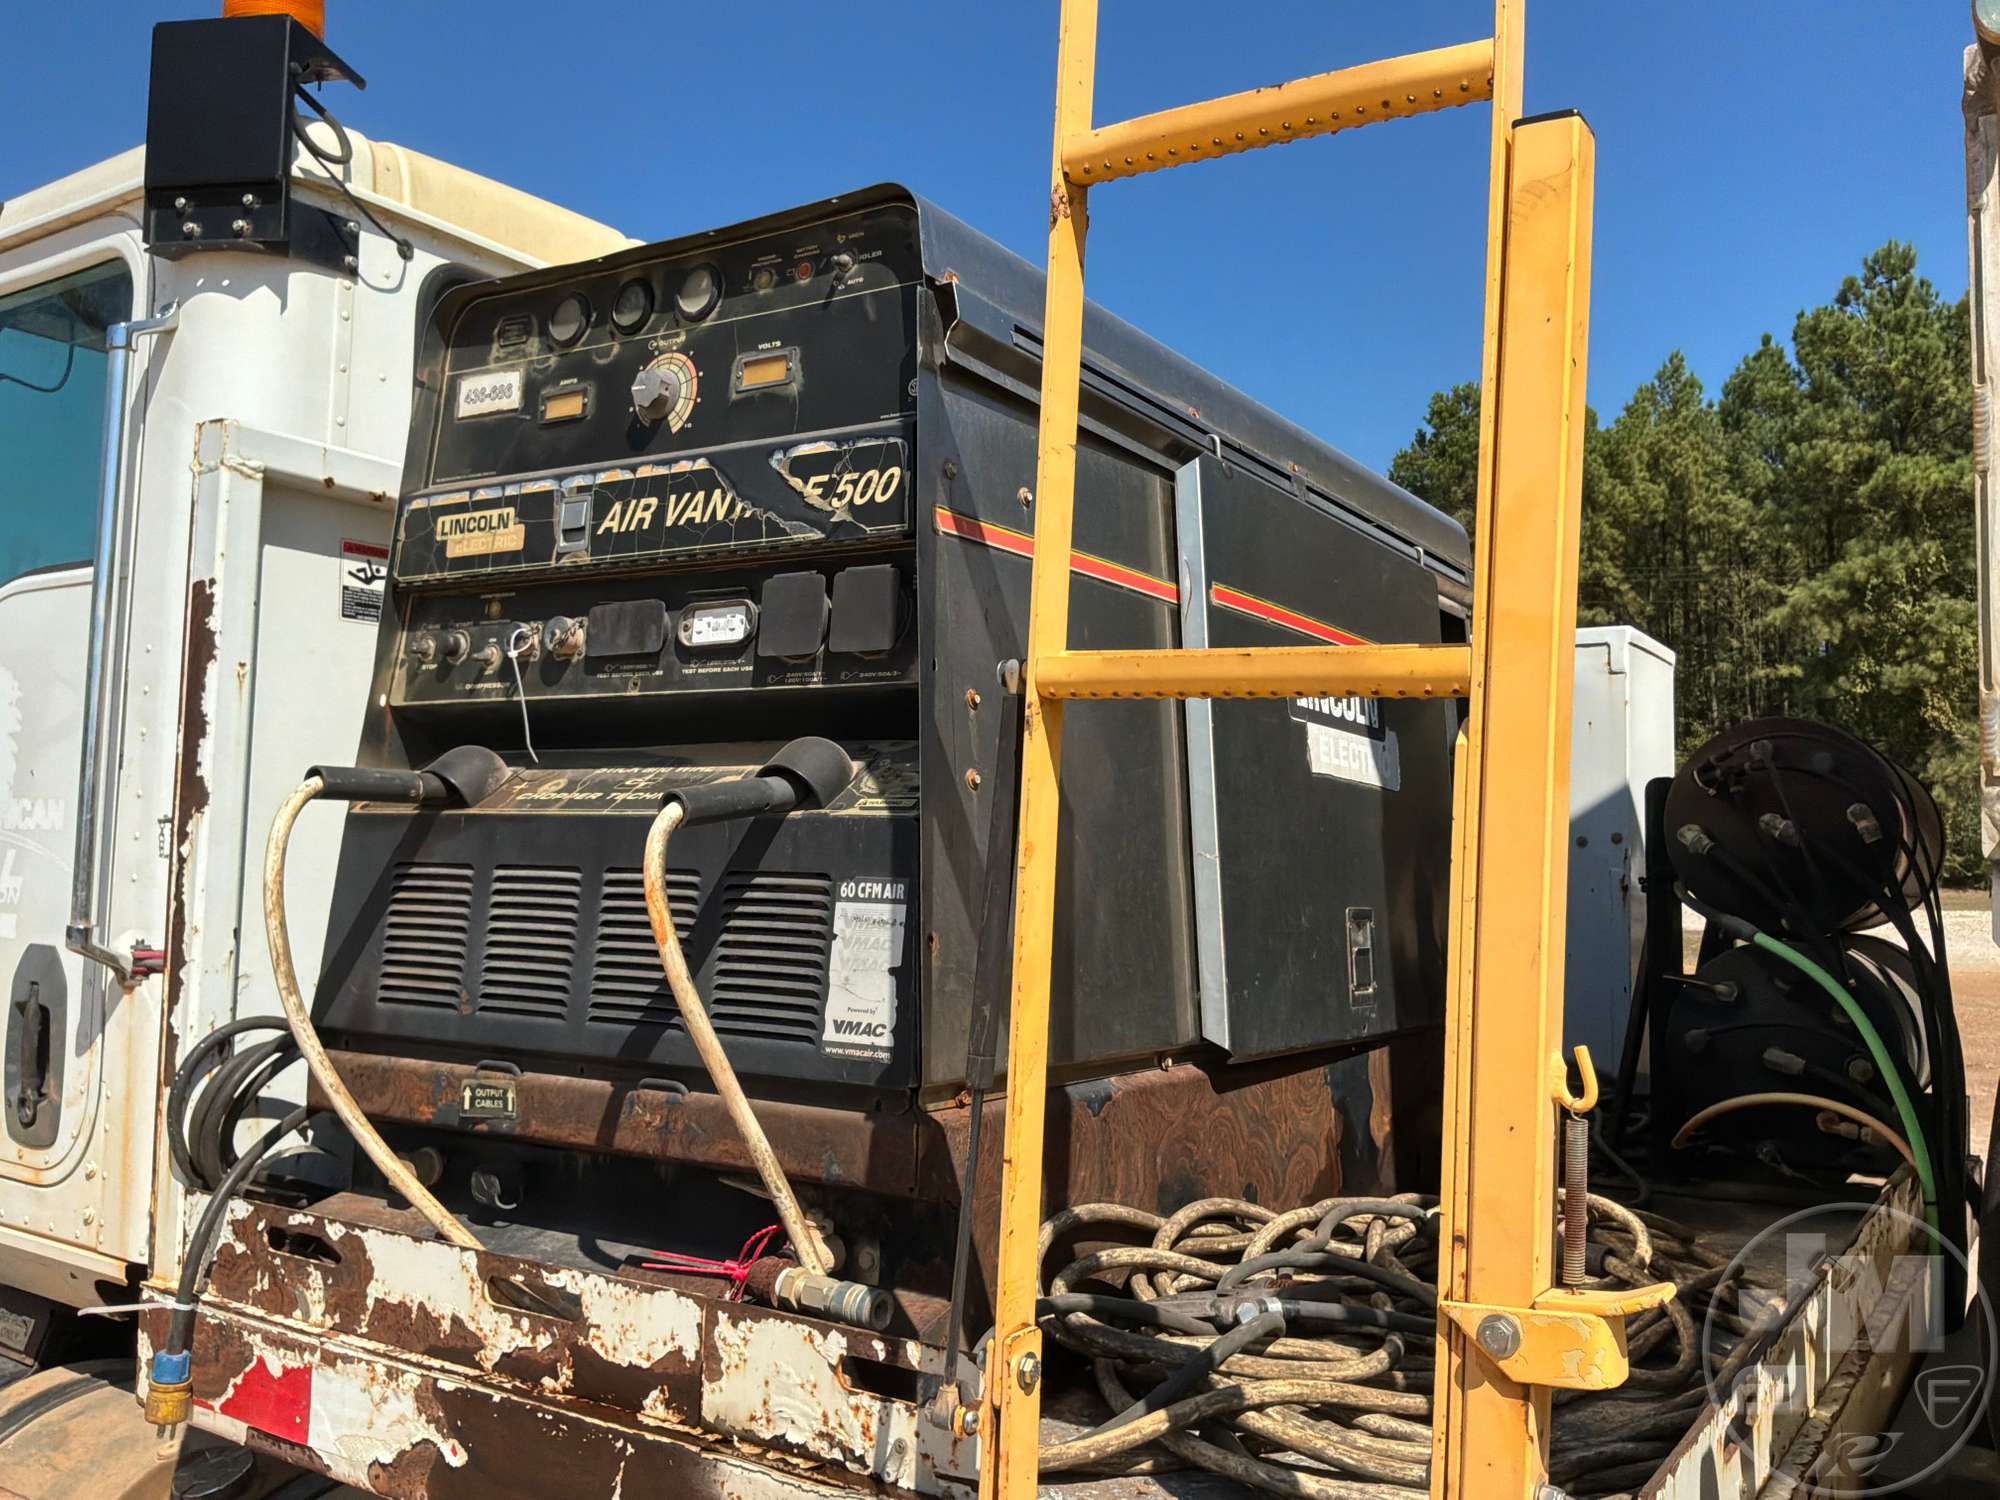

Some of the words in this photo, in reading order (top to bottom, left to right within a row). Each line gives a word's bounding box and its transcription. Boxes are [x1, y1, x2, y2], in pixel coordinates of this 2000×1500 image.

[758, 340, 782, 352] VOLTS
[596, 496, 659, 535] AIR
[830, 465, 902, 509] 500
[441, 511, 510, 536] LINCOLN
[516, 792, 603, 801] CHOPPER
[840, 882, 856, 898] 60
[858, 882, 883, 899] CFM
[883, 883, 905, 900] AIR
[847, 1006, 870, 1015] Powered
[832, 1019, 887, 1037] VMAC
[825, 1046, 891, 1060] www.vmacair.com
[475, 1087, 504, 1098] OUTPUT
[475, 1098, 504, 1109] CABLES
